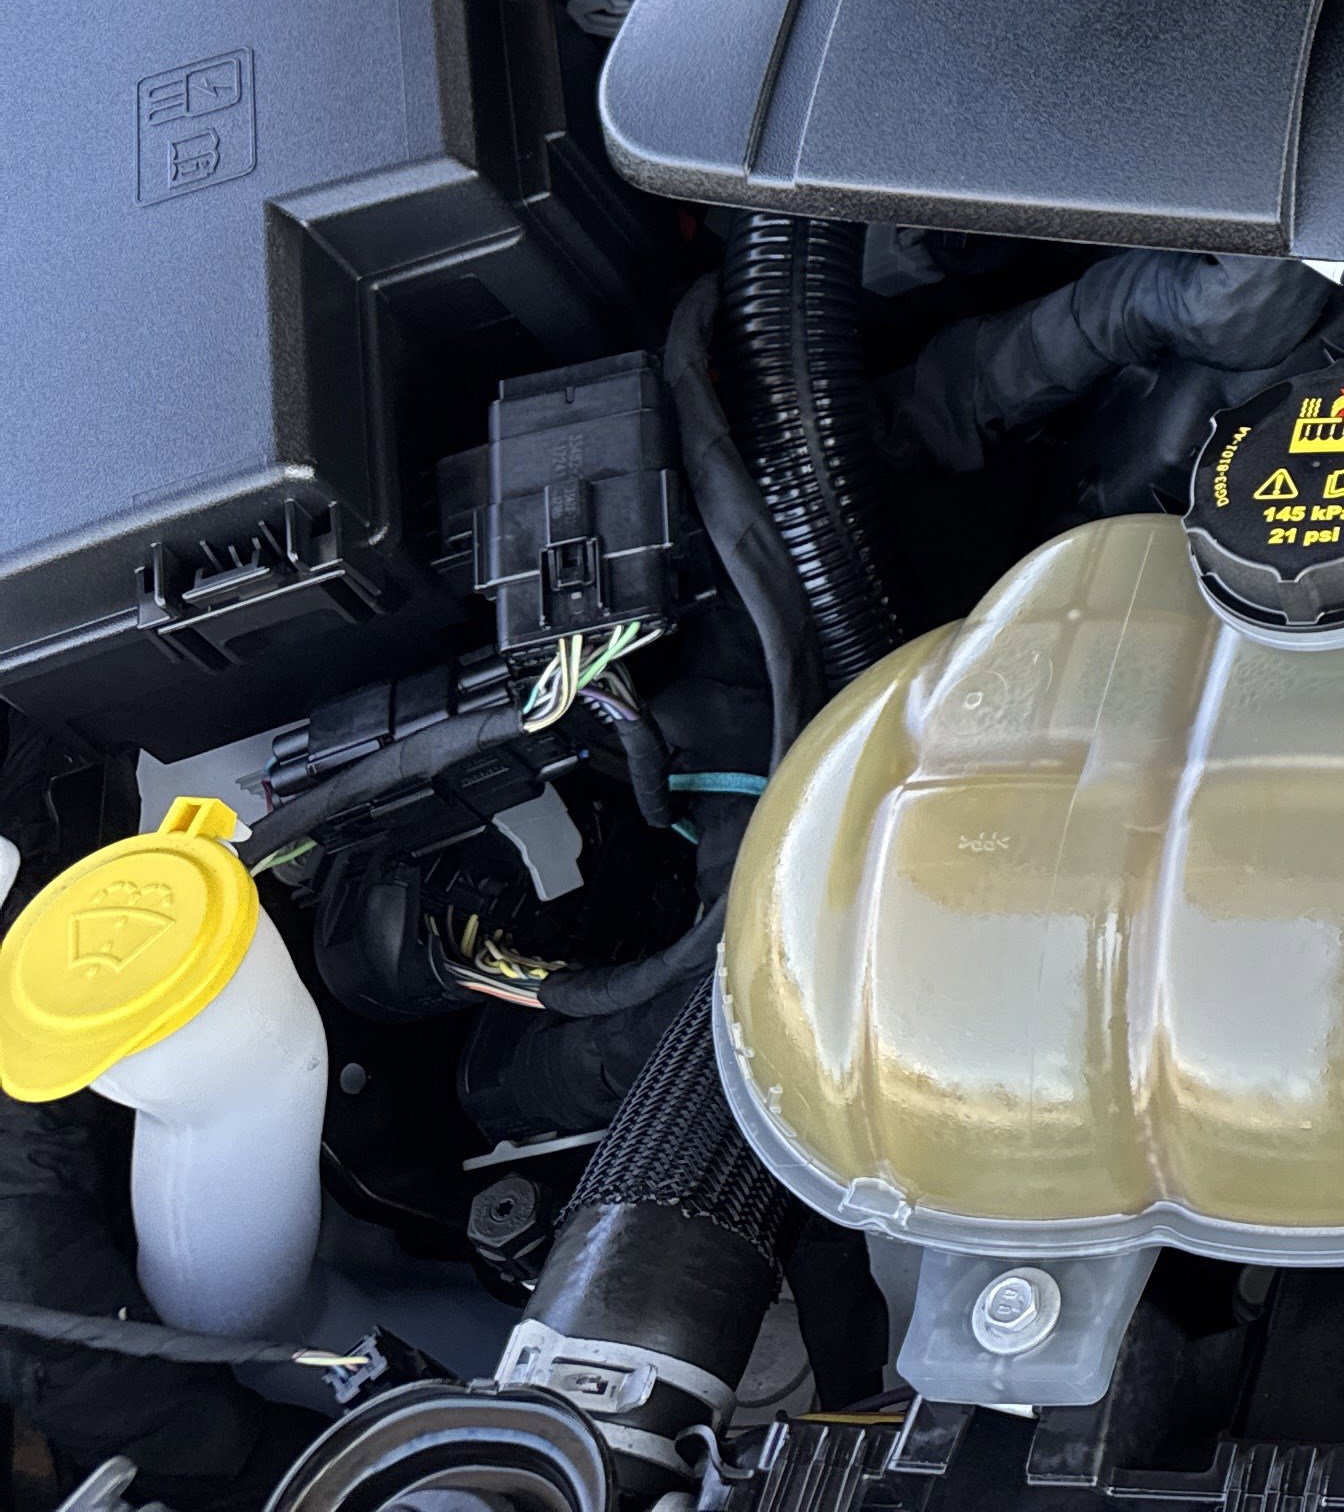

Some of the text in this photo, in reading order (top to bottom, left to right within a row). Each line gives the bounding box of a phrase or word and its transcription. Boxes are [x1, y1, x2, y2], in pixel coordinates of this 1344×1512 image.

[1213, 426, 1252, 508] DG93-8101-AA
[1263, 506, 1306, 523] 145
[1267, 527, 1341, 547] 21 psi
